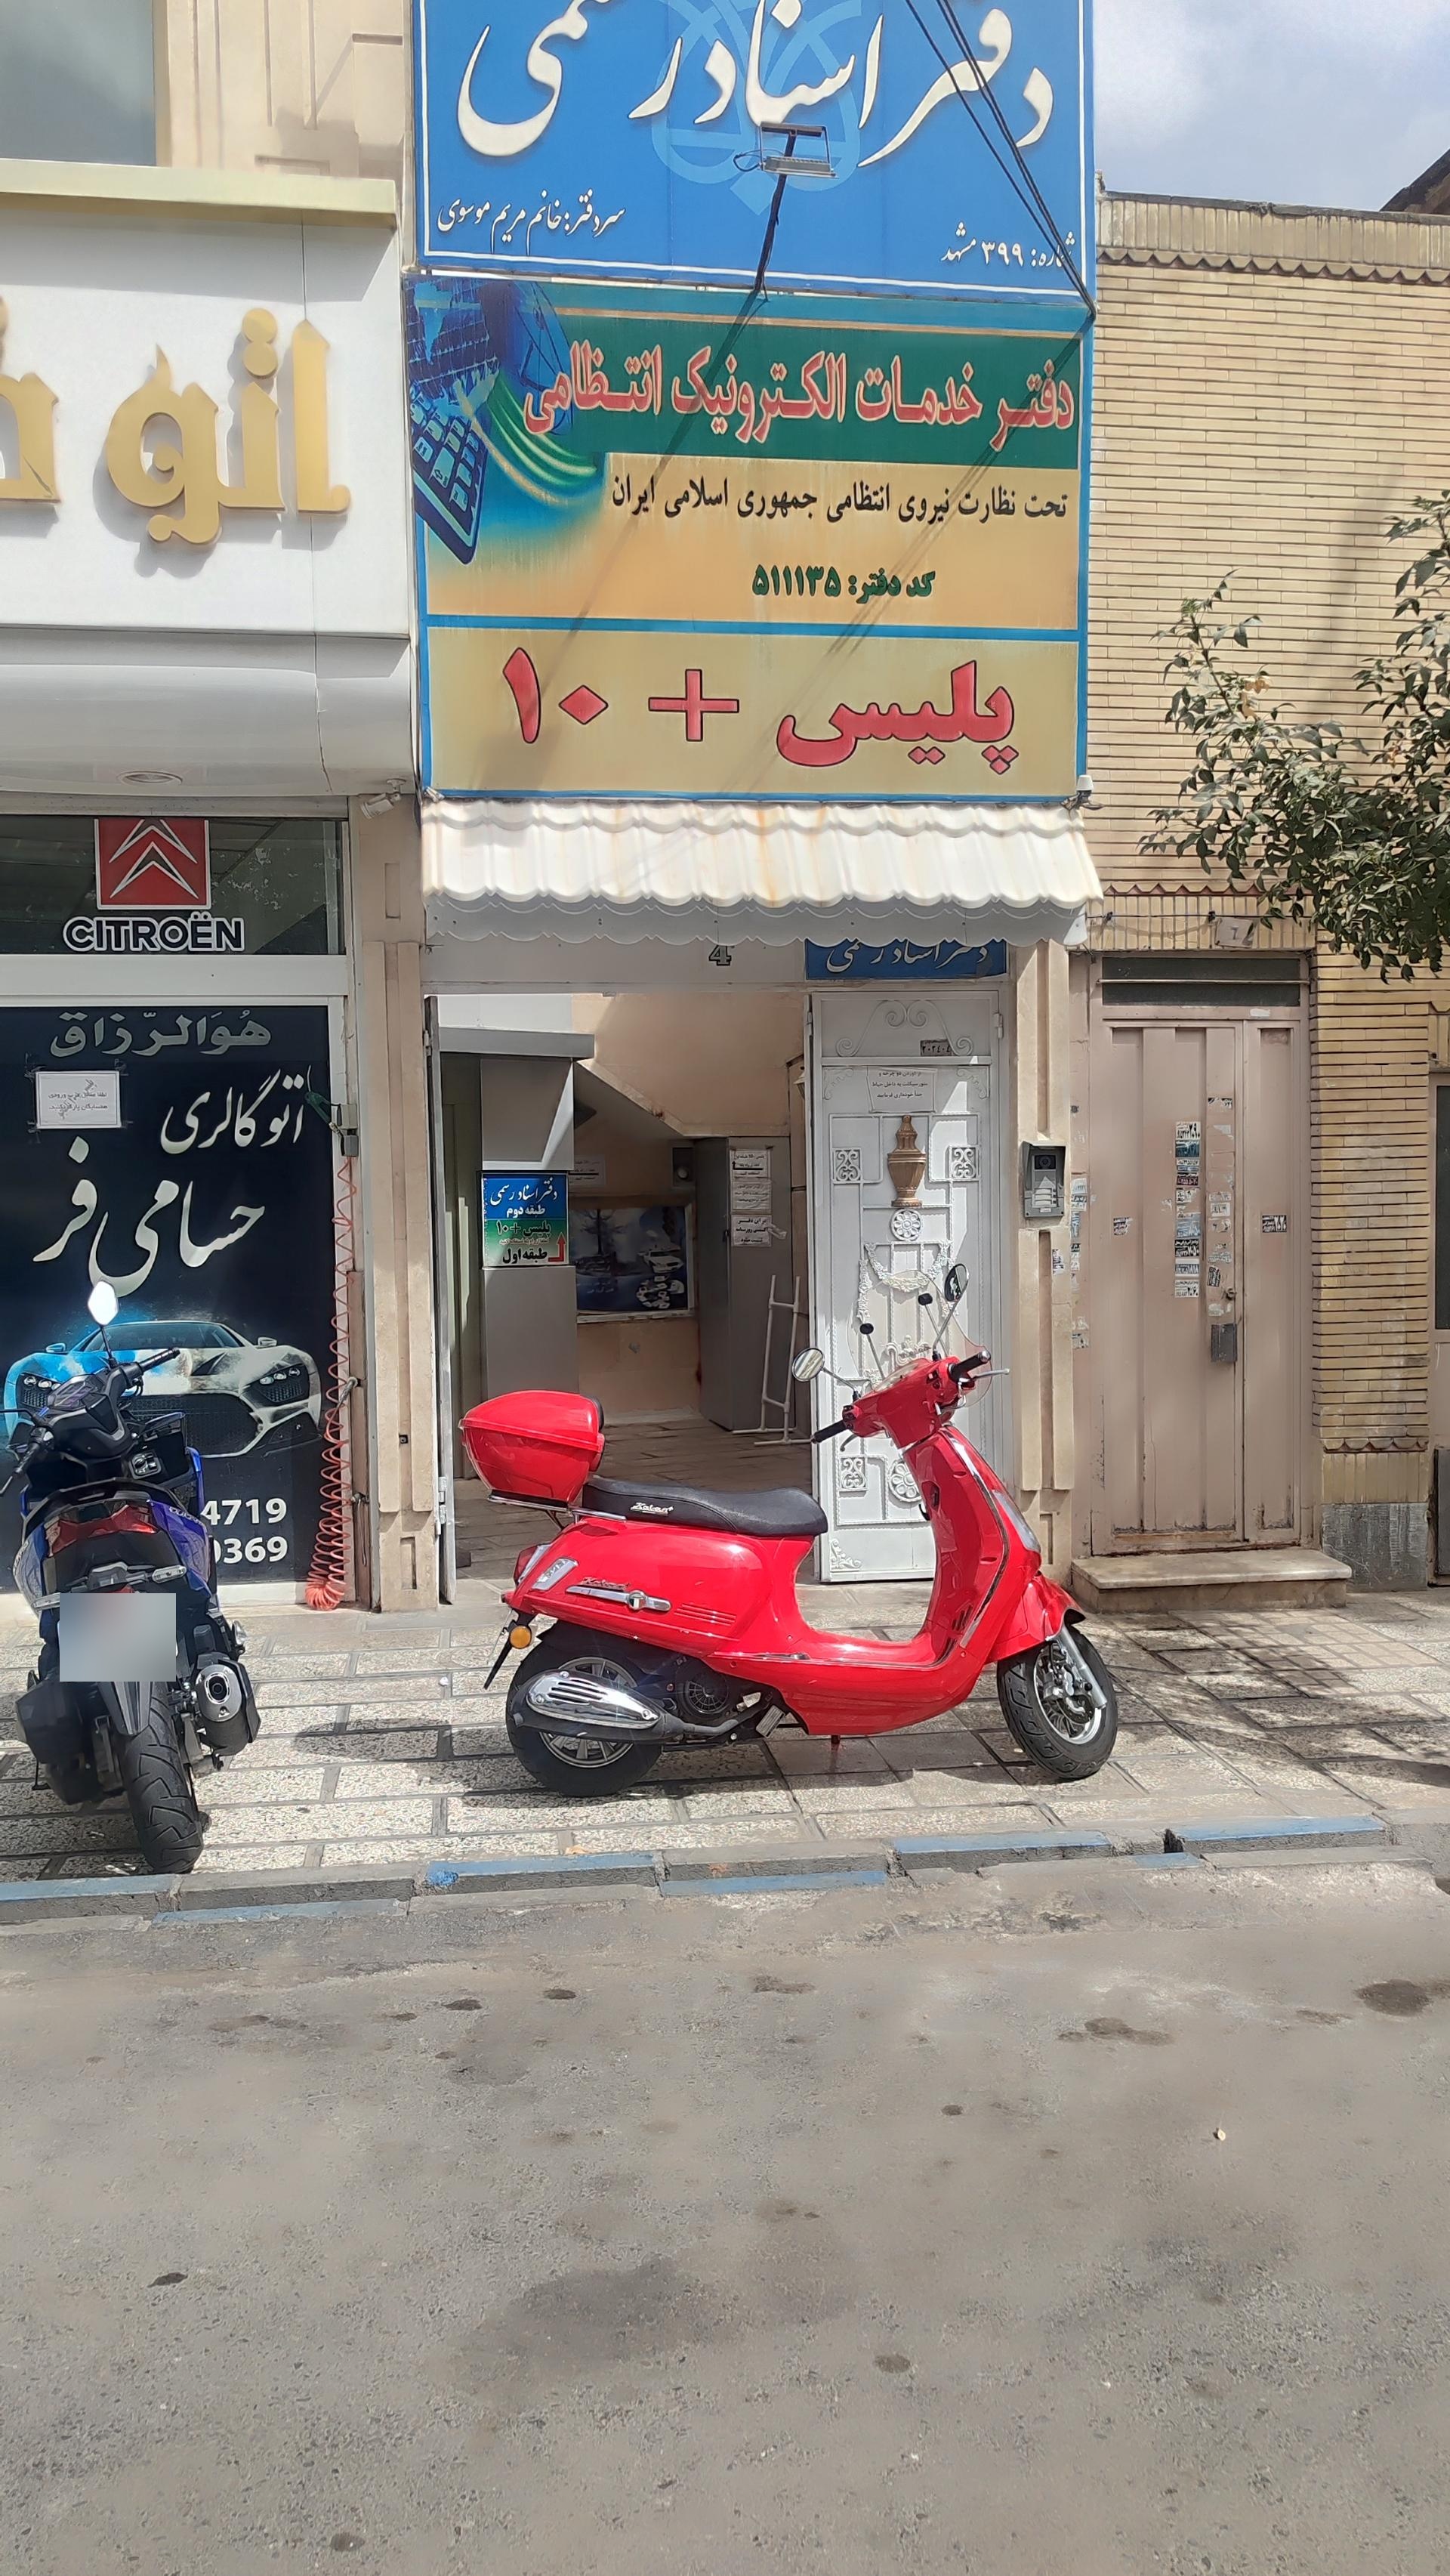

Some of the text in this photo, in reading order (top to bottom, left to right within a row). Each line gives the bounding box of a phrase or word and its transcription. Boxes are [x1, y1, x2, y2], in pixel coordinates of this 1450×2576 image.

[437, 198, 492, 233] موسوی
[491, 202, 526, 255] مریم
[526, 189, 563, 257] خانم
[939, 221, 977, 262] مشهد
[981, 241, 1024, 267] ۳۹۹
[524, 338, 1075, 452] دفتر خدمات الکترونیک انتظامی
[612, 473, 1069, 525] تحت نظارت نیروی انتظامی جمهوری اسلامی ایران
[751, 564, 842, 598] ۵۱۱۱۳۵
[905, 570, 936, 598] کد
[502, 646, 609, 745] ۱۰
[776, 659, 1020, 775] پلیس
[63, 911, 245, 952] CITROËN
[535, 1176, 557, 1204] دفتر
[506, 1204, 545, 1219] طبقه دوم
[522, 1220, 551, 1237] پلیس
[502, 1247, 548, 1264] طبقه اول
